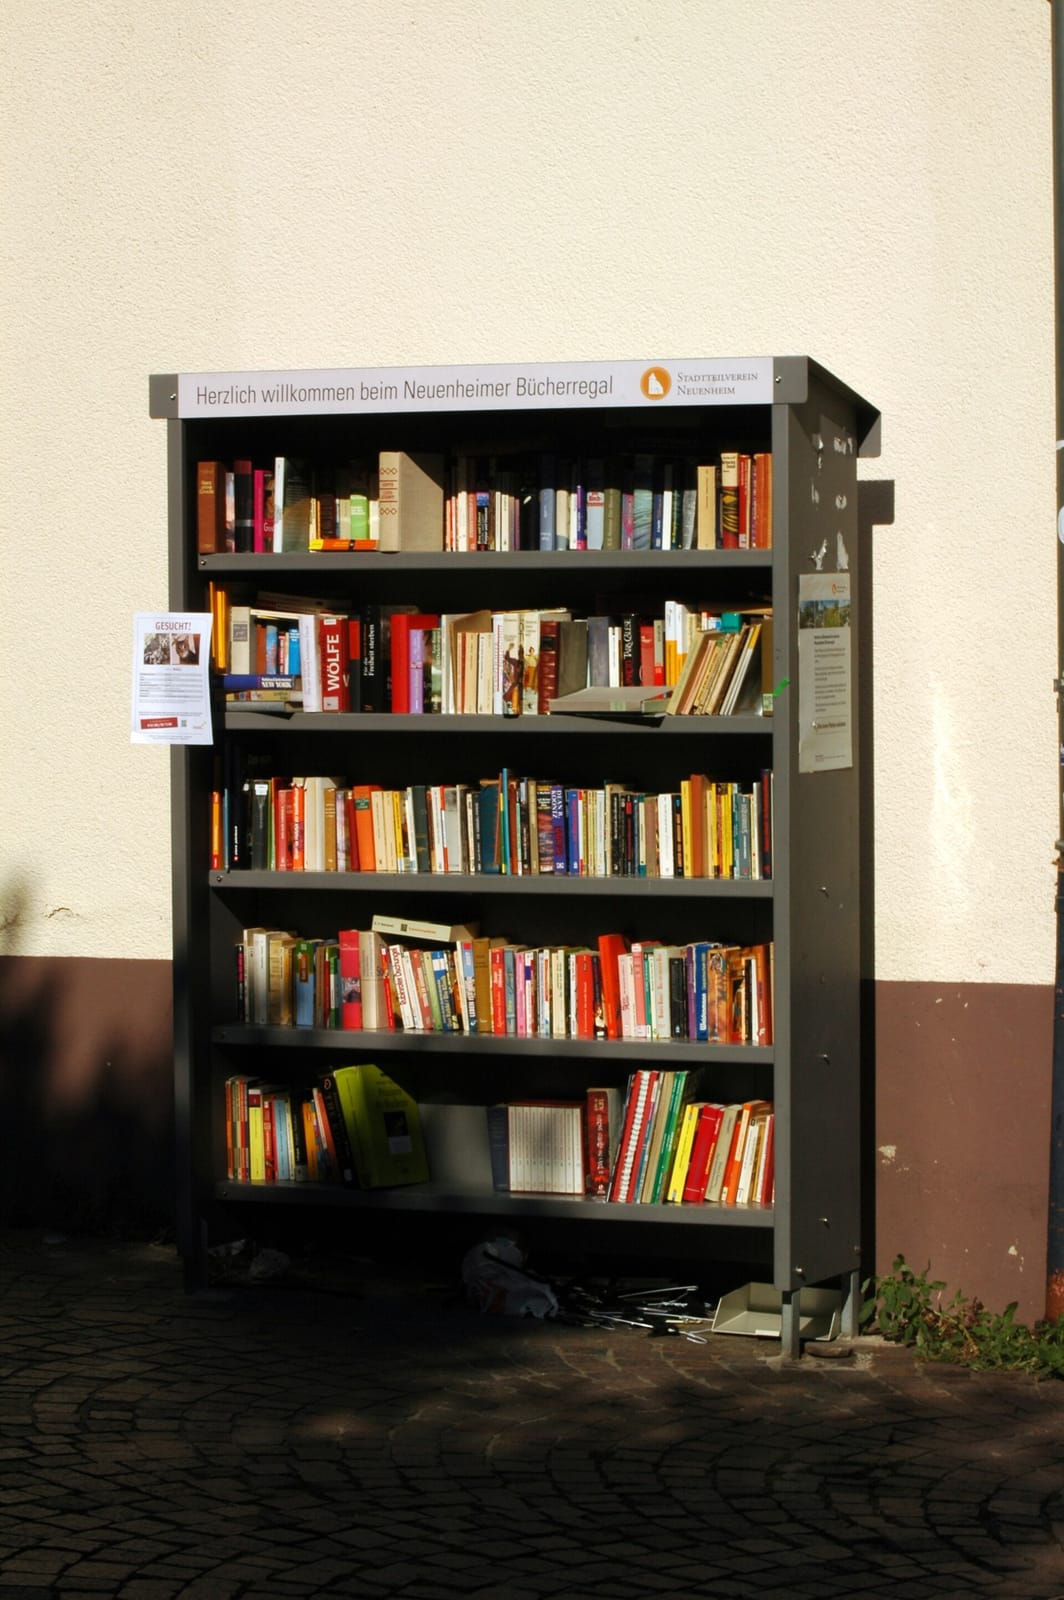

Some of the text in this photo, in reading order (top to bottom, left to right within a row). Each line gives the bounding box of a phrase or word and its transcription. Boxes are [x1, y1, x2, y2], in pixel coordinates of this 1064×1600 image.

[196, 375, 613, 406] Herzlich willkommen beim Neuenheimer Bücherregal
[677, 384, 736, 396] NEUENHEIM
[155, 621, 192, 631] GESUCHT!
[327, 634, 340, 691] WÖLFE
